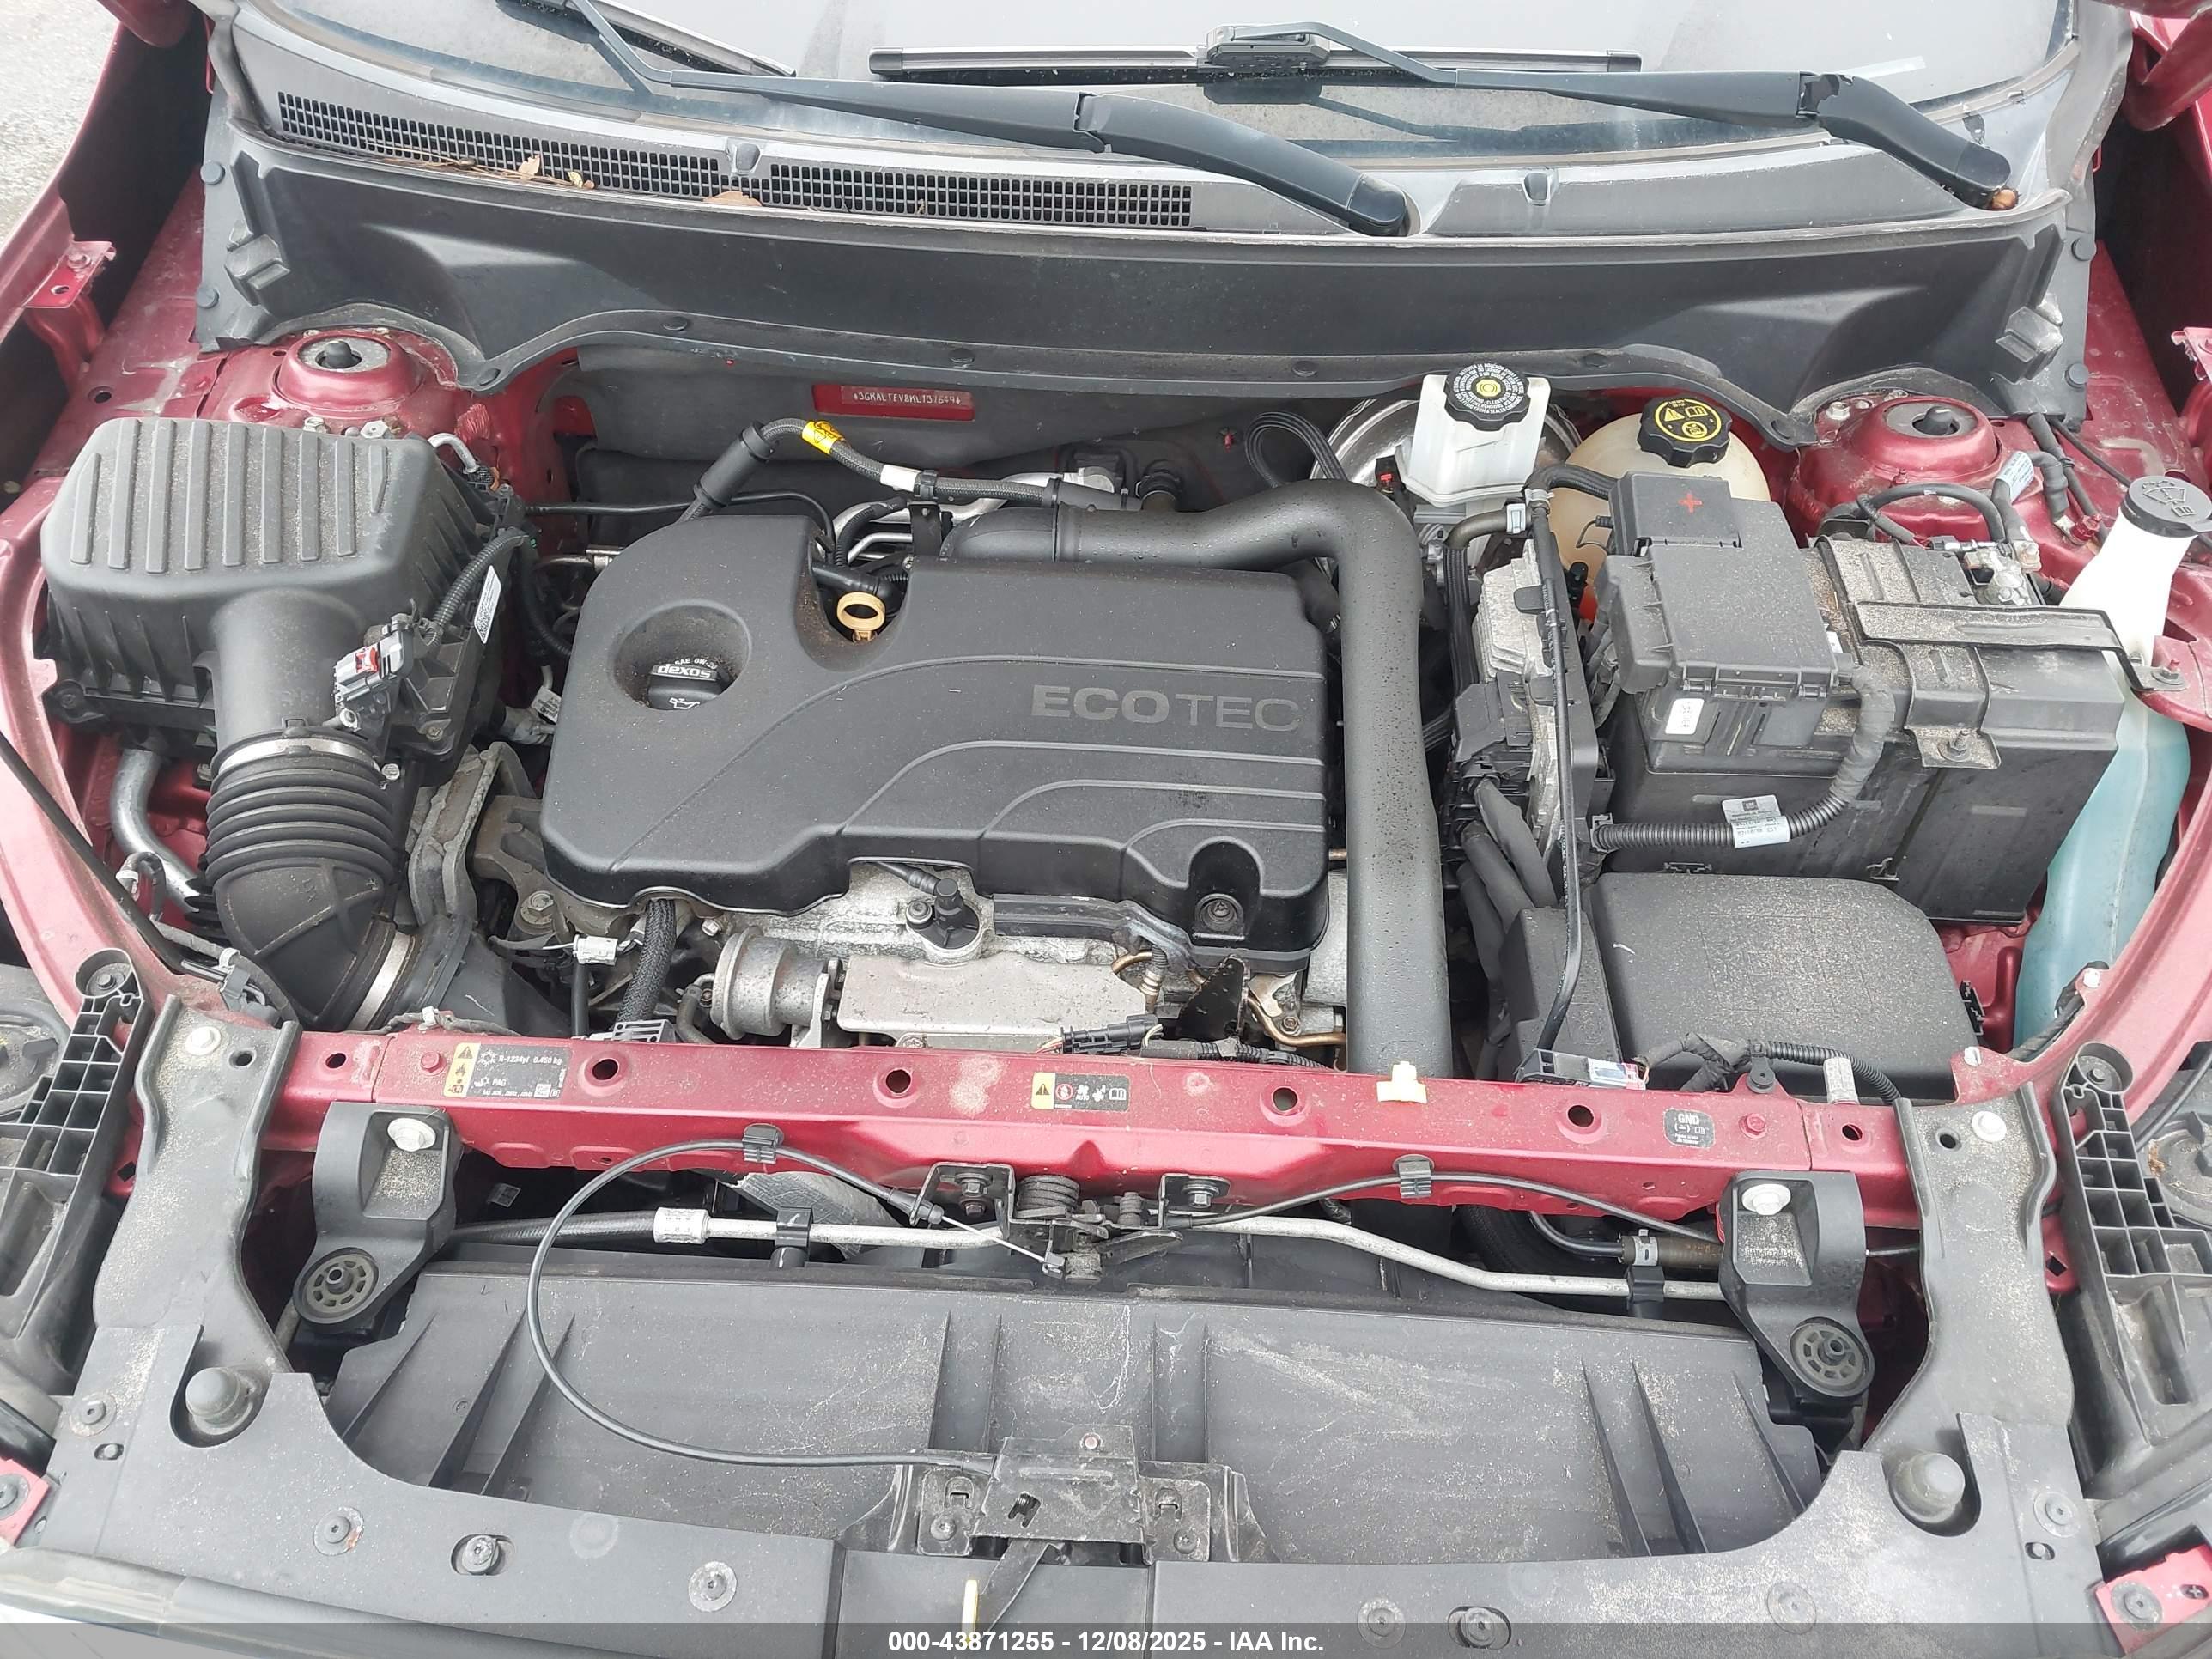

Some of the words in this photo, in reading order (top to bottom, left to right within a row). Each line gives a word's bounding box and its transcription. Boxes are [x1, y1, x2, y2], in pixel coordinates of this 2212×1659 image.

[657, 664, 711, 678] dexos
[1031, 684, 1300, 732] ECOTEC
[1677, 1113, 1700, 1125] GND
